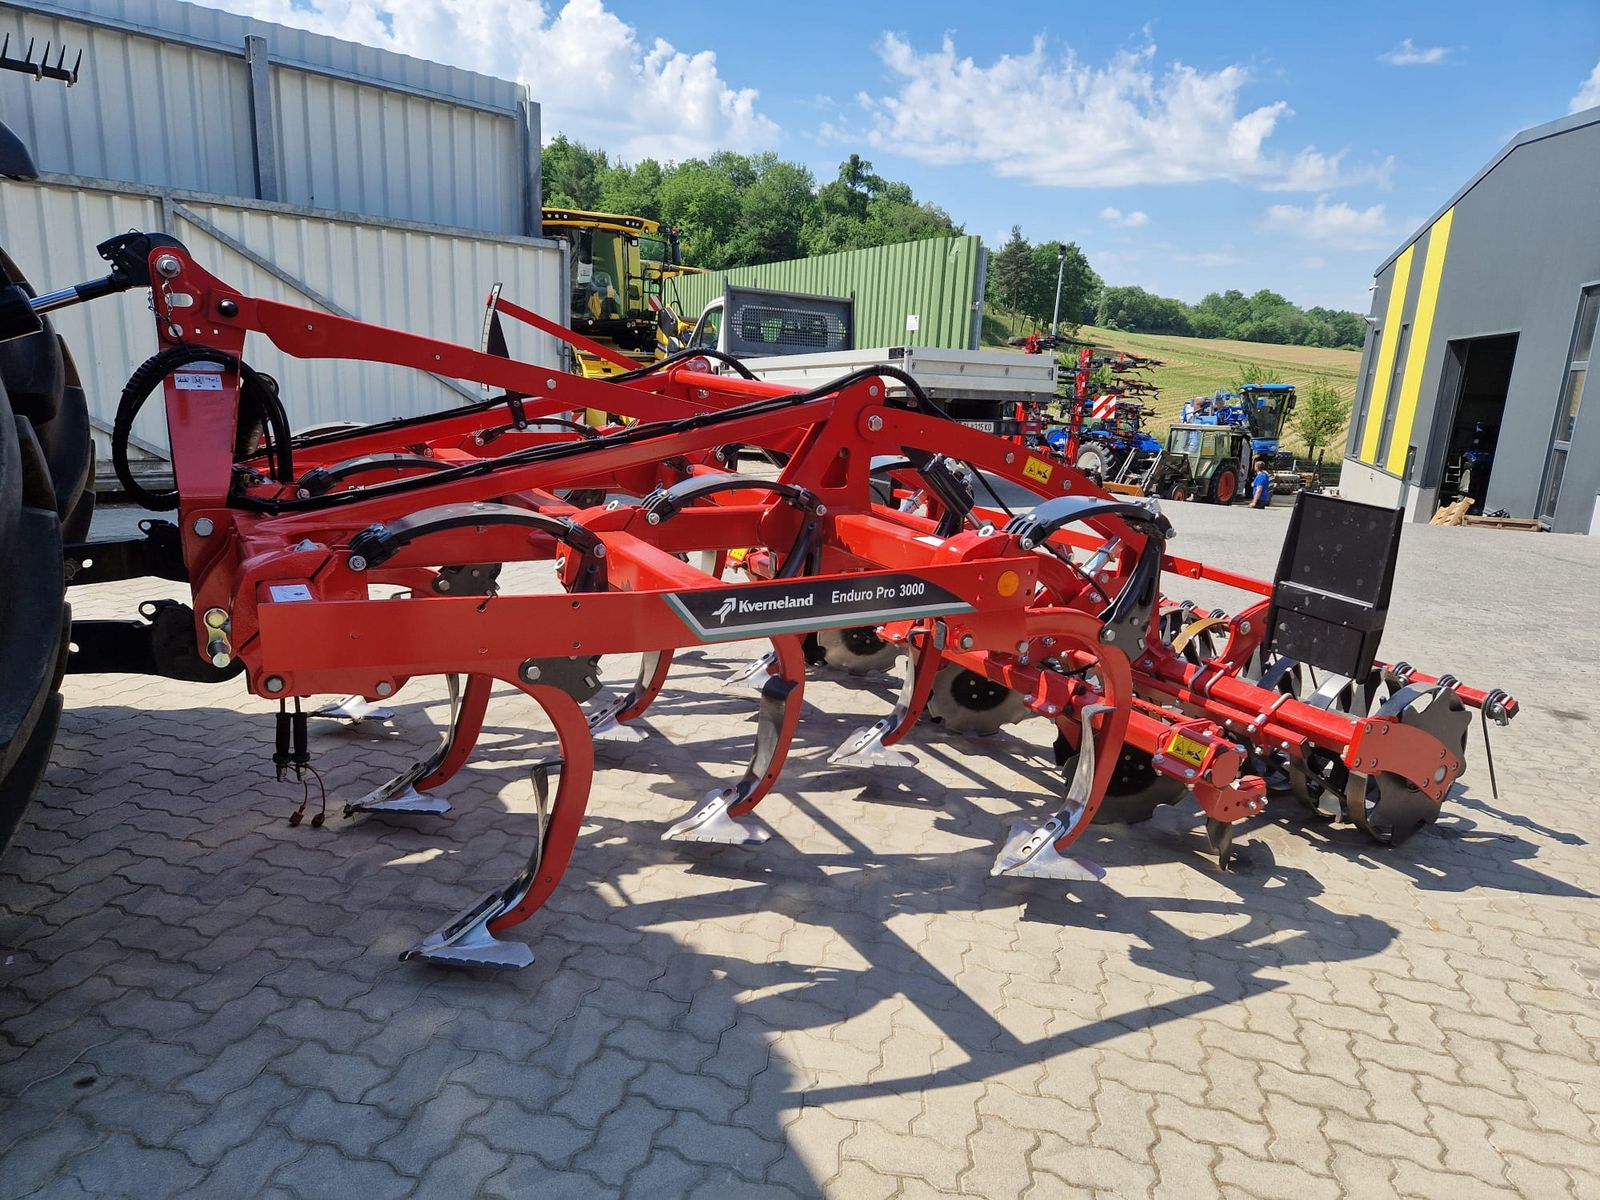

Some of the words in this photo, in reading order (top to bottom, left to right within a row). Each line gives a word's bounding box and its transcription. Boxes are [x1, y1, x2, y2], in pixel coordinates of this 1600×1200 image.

[738, 593, 814, 614] Kverneland
[831, 589, 873, 604] Enduro
[876, 586, 896, 599] Pro
[899, 582, 925, 597] 3000
